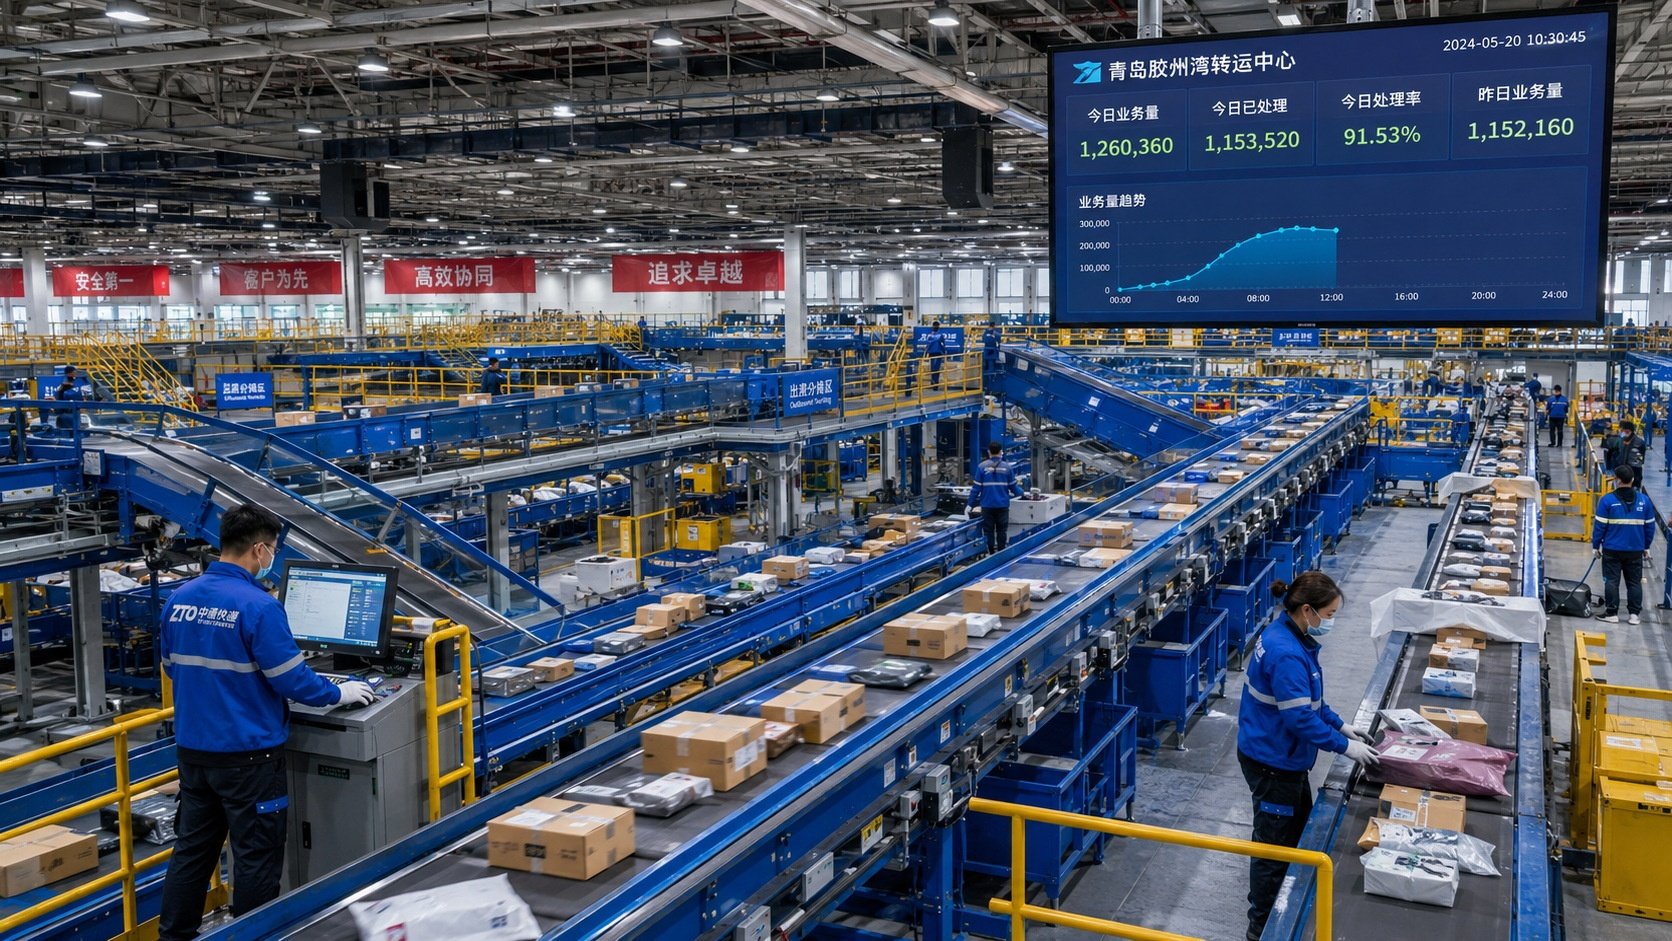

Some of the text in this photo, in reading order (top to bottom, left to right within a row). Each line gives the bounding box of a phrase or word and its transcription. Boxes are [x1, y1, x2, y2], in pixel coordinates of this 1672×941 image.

[1443, 30, 1587, 51] 2024-05-20 10:30:45
[1108, 50, 1296, 82] 青岛胶州湾转运中心
[1341, 90, 1422, 110] 今日处理率
[1478, 82, 1563, 102] 昨日业务量
[1087, 104, 1160, 124] 今日业务量
[1212, 98, 1288, 117] 今日已处理
[1343, 125, 1421, 146] 91.53%
[1468, 117, 1575, 143] 1,152,160
[1080, 137, 1174, 161] 1,260,360
[1205, 130, 1300, 155] 1,153,520
[1078, 193, 1146, 209] 业务量趋势
[1079, 219, 1110, 229] 300,000
[1079, 241, 1111, 251] 200,000
[414, 265, 494, 288] 高效协同
[648, 260, 744, 286] 追求卓越
[1079, 263, 1111, 273] 100,000
[75, 271, 134, 292] 安全第一
[1104, 286, 1111, 295] 0
[1109, 295, 1132, 305] 00:00
[1176, 295, 1200, 304] 04:00
[1246, 294, 1270, 303] 08:00
[1320, 293, 1344, 302] 12:00
[1395, 292, 1419, 301] 16:00
[1471, 291, 1497, 300] 20:00
[1541, 290, 1568, 299] 24:00
[169, 604, 198, 623] ZTO
